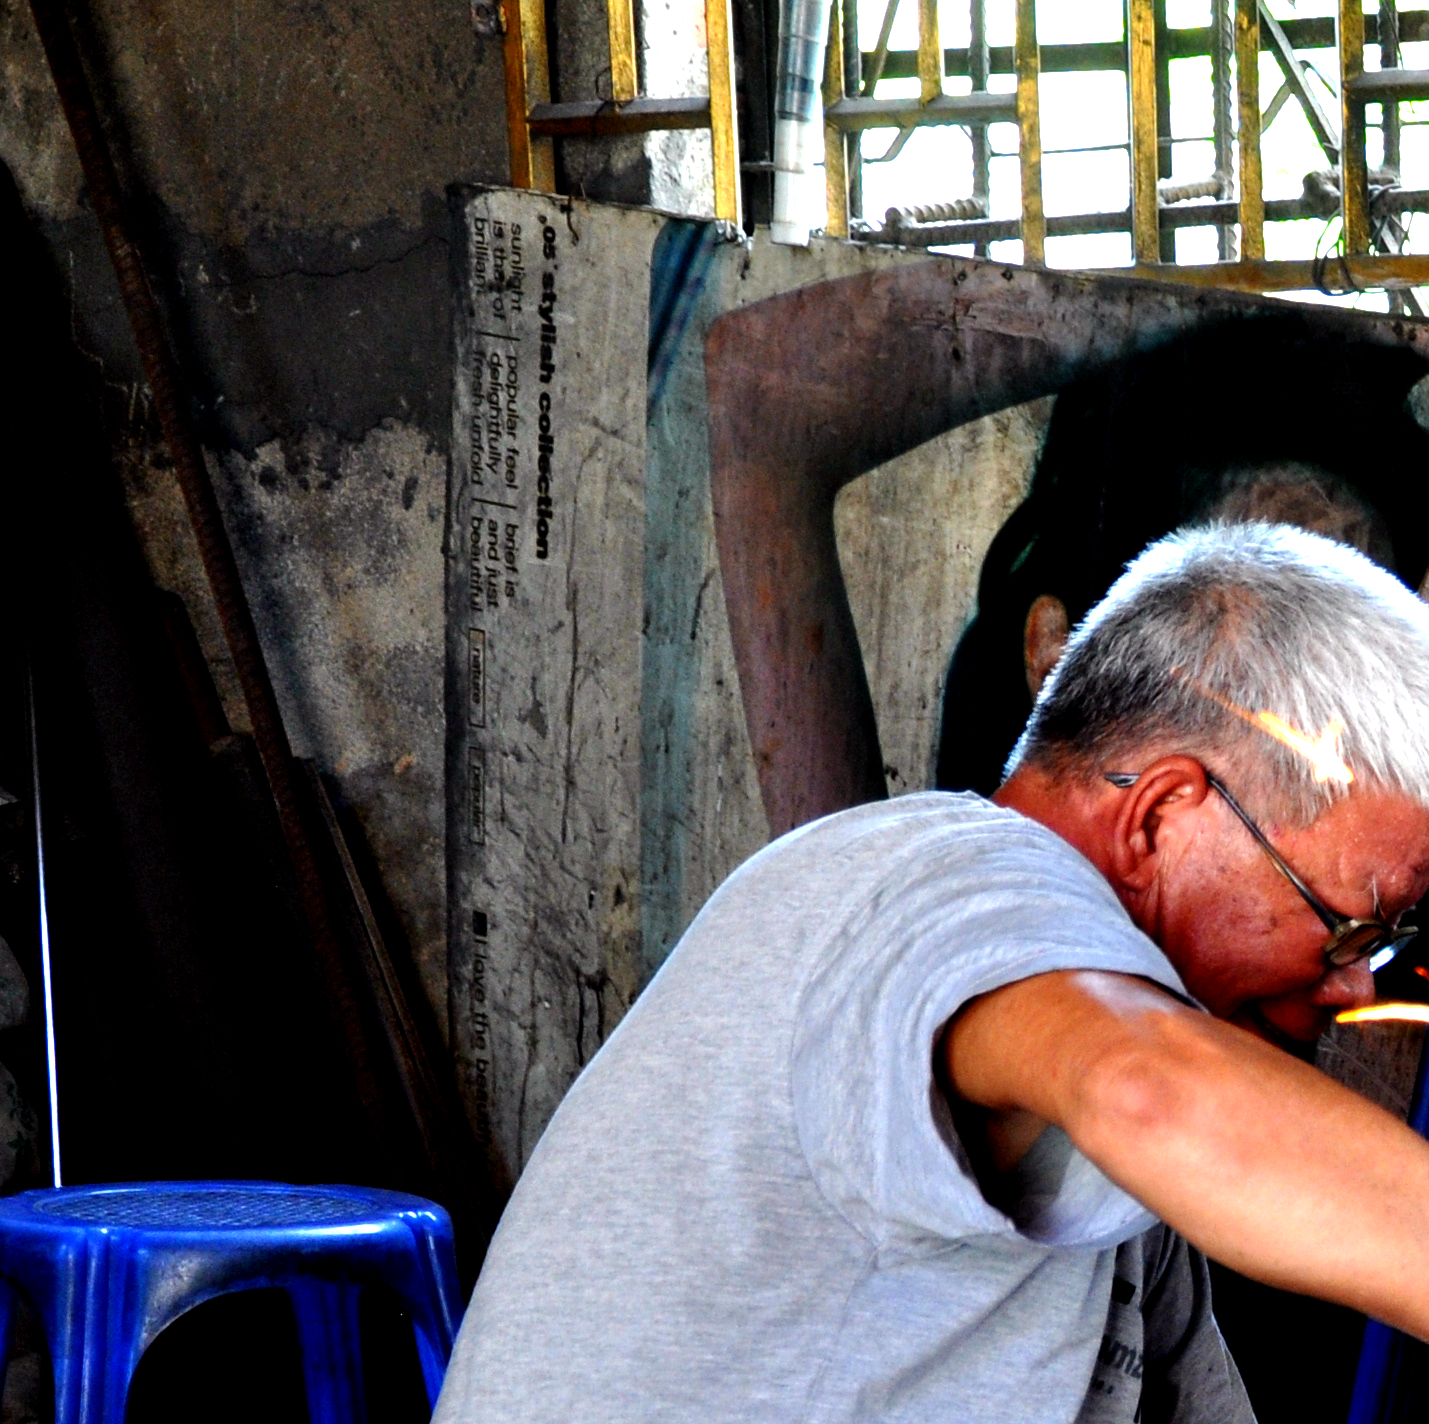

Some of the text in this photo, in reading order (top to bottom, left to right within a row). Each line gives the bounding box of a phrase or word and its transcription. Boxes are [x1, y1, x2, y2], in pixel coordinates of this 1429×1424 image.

[493, 219, 505, 239] is
[507, 222, 525, 313] sunlight
[493, 297, 506, 322] of
[538, 271, 557, 384] stylish
[471, 349, 486, 487] fresh unfold
[486, 352, 504, 475] delightfully
[505, 355, 520, 490] popular feel
[536, 392, 554, 560] collection
[470, 516, 484, 613] beautiful
[485, 519, 500, 609] and just
[505, 523, 519, 599] brief is
[471, 647, 482, 705] nature
[473, 953, 487, 1003] love
[474, 1012, 488, 1050] the
